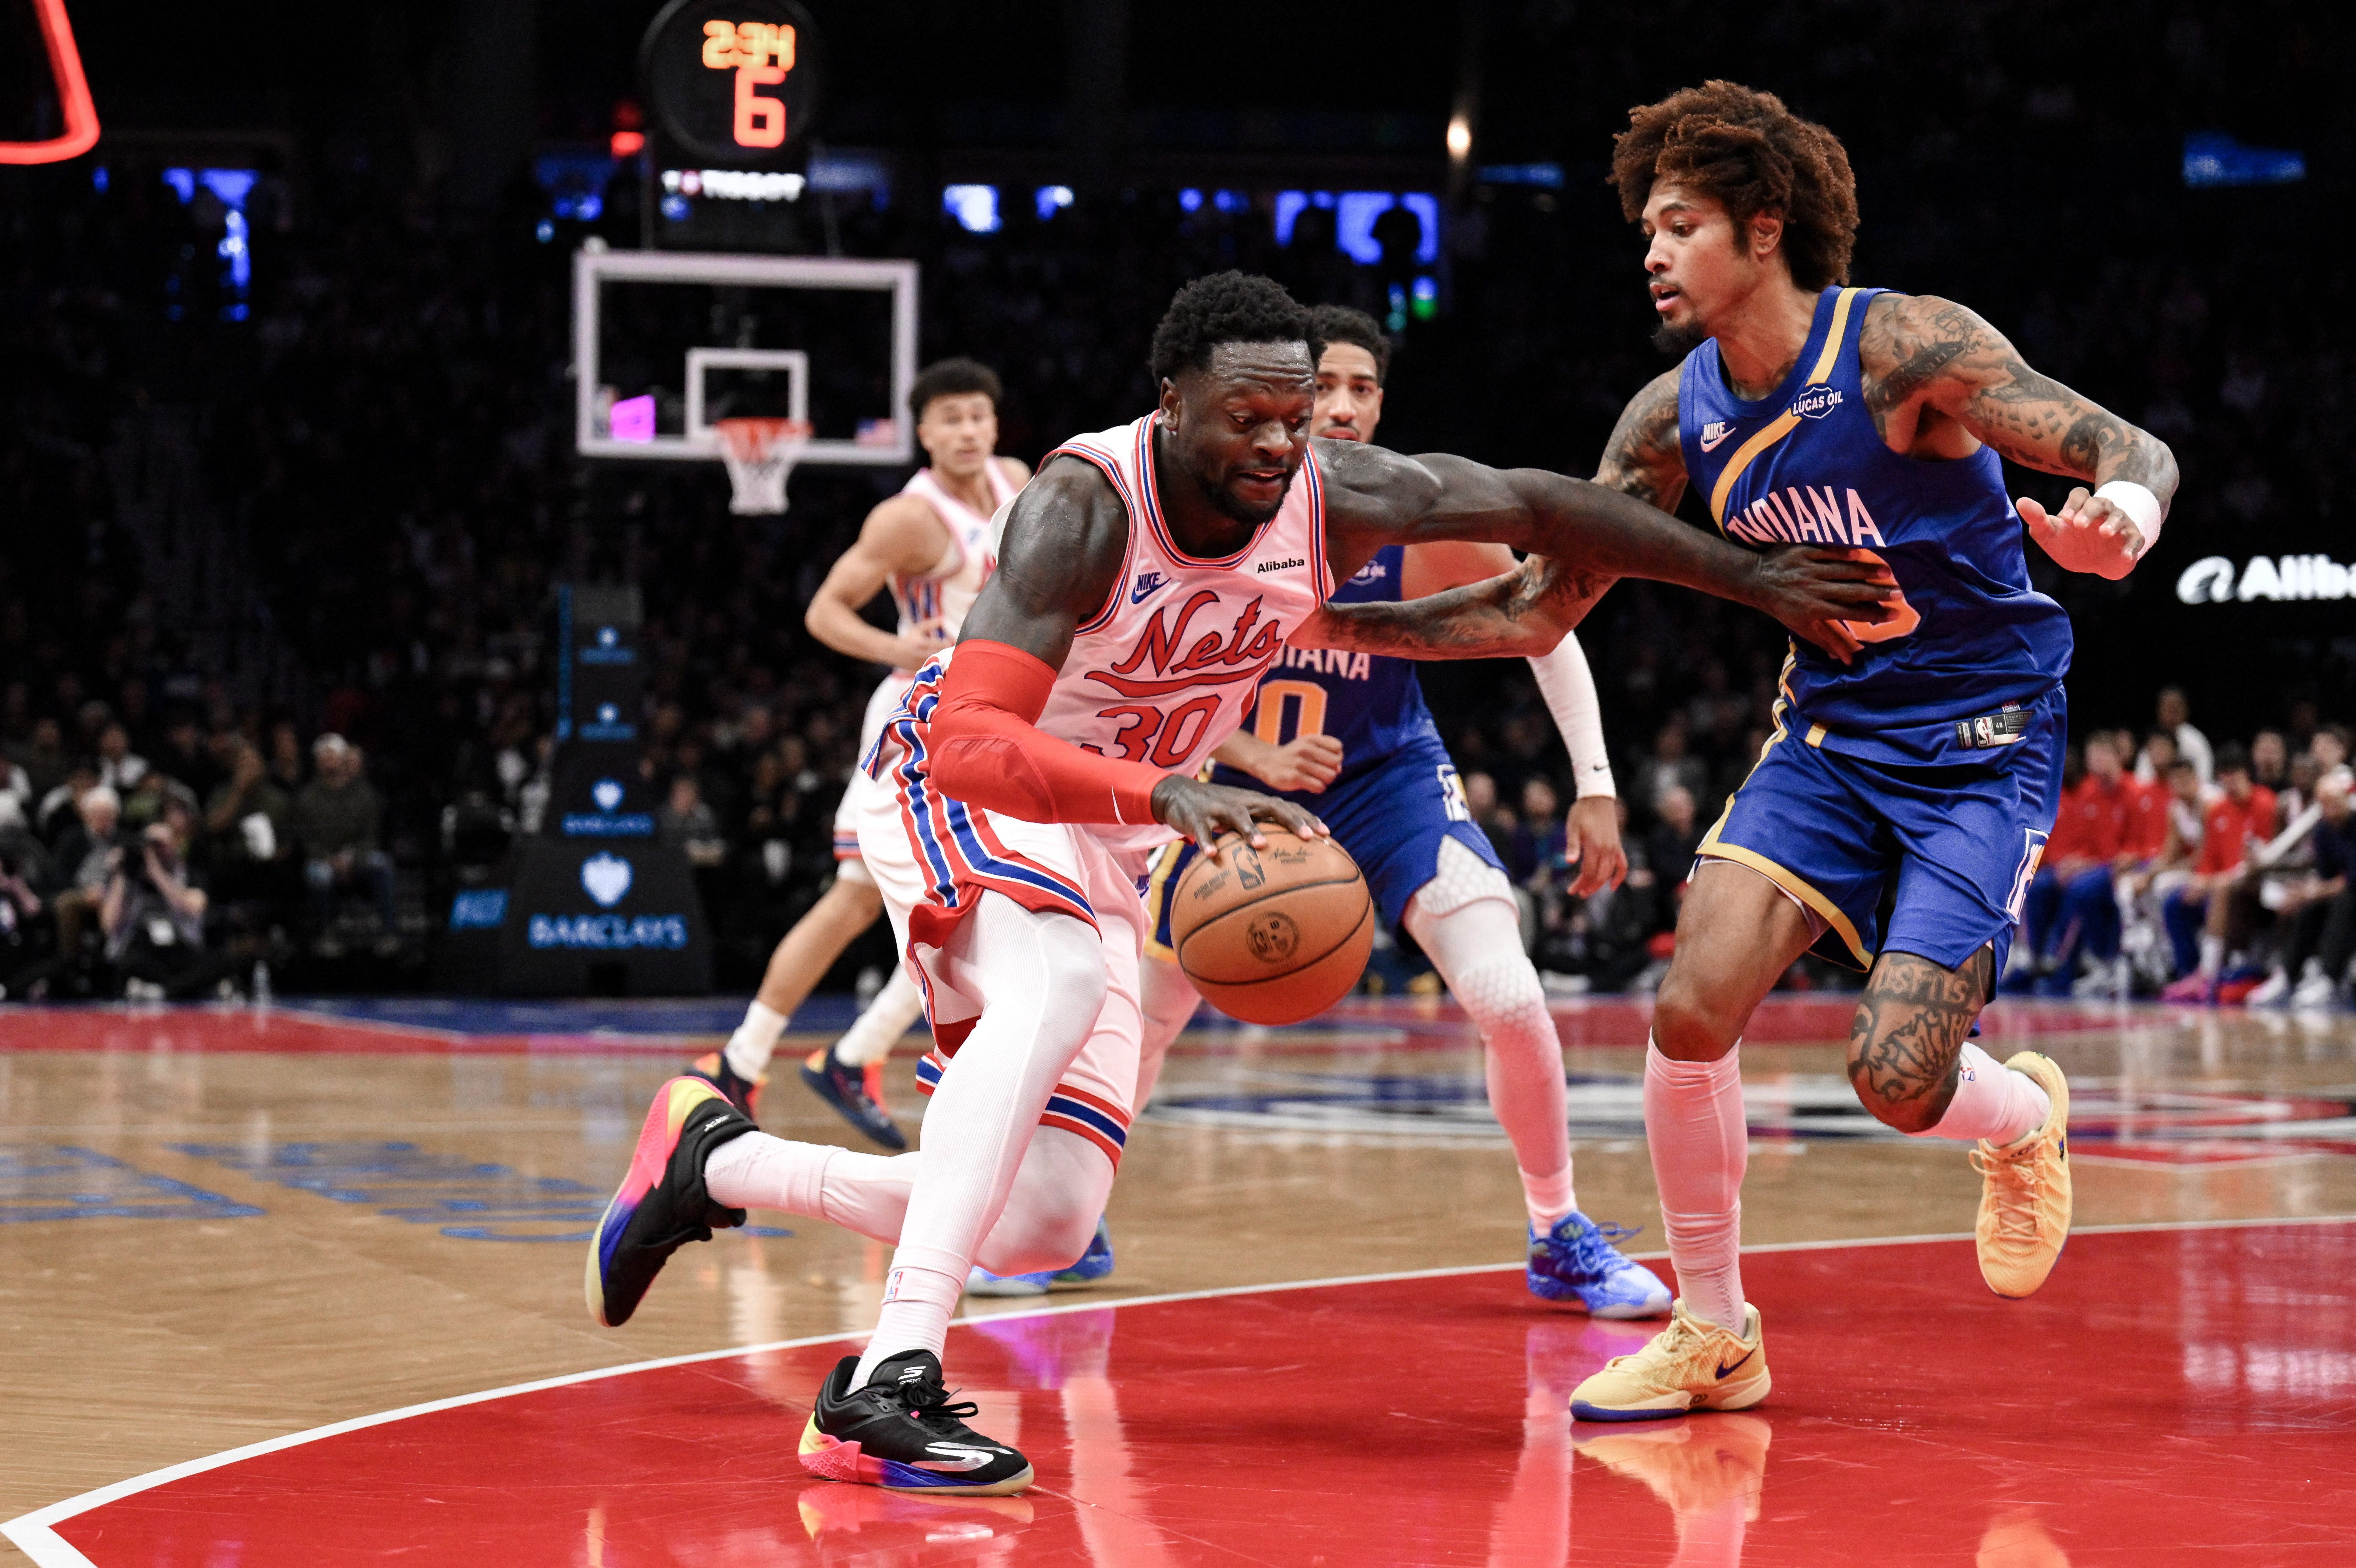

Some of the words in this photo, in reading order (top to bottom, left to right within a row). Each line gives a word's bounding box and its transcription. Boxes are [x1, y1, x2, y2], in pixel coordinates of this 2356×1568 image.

[734, 67, 785, 147] 6
[1793, 395, 1825, 415] LUCAS
[1827, 391, 1843, 406] OIL
[1703, 421, 1726, 441] NIKE
[1726, 486, 1886, 548] NDIANA
[1136, 572, 1161, 591] NIKE
[1257, 558, 1305, 573] Alibaba
[2237, 554, 2356, 602] Alib
[1111, 590, 1283, 678] Nets
[1080, 693, 1223, 768] 30
